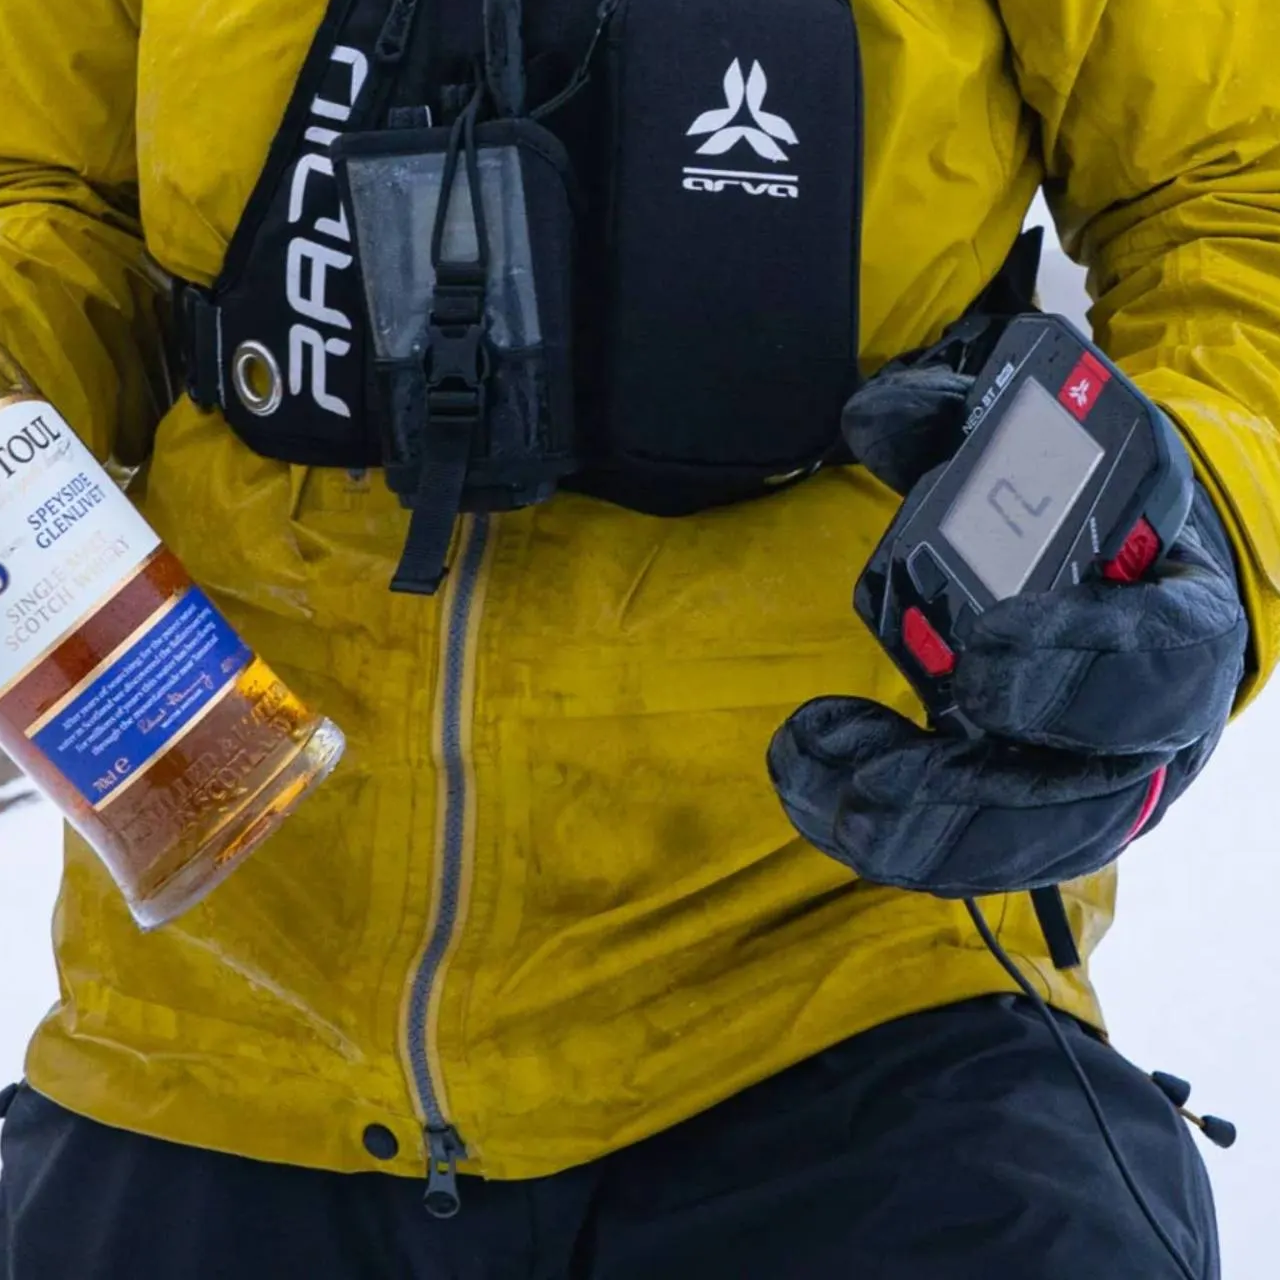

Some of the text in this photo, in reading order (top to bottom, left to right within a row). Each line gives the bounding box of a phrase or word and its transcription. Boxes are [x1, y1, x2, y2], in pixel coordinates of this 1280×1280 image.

[682, 177, 798, 198] arva
[962, 406, 984, 434] NEO
[26, 472, 93, 531] SPEYSIDE
[34, 485, 108, 550] GLENLIVET
[4, 587, 75, 652] SCOTCH
[5, 568, 69, 625] SINGLE
